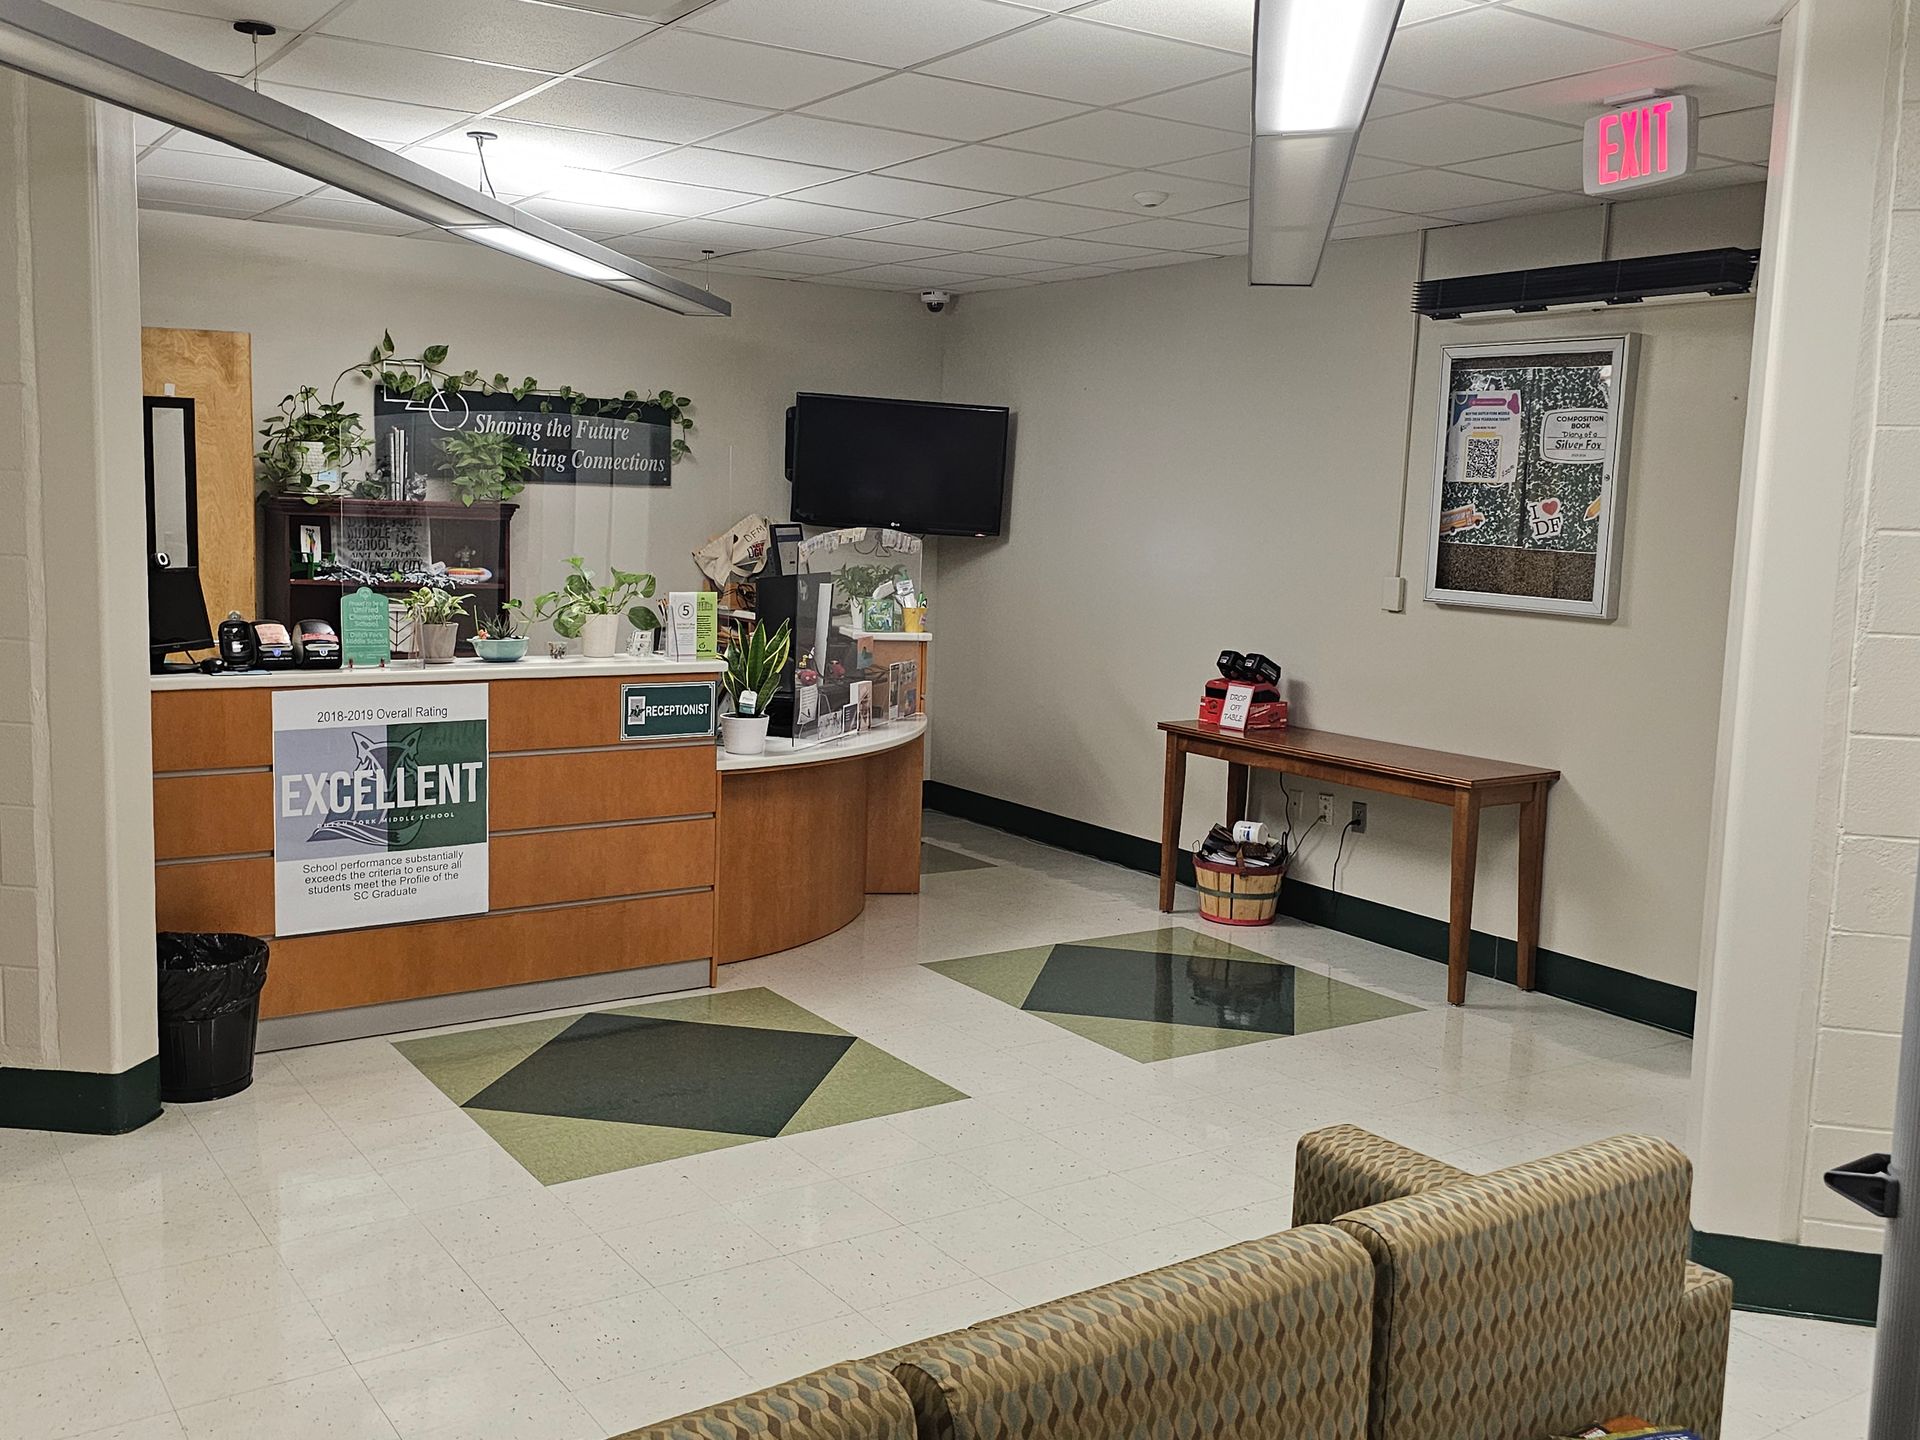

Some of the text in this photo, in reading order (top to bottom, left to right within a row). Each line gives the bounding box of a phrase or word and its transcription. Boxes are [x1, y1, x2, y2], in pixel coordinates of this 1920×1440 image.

[1599, 102, 1673, 185] EXIT
[474, 413, 630, 441] Shaping the Future
[1562, 431, 1582, 439] Diary
[1555, 439, 1602, 450] Silver Fox
[571, 449, 666, 473] Connections
[1531, 505, 1538, 520] I
[347, 527, 391, 539] MIDDLE
[743, 524, 765, 542] DFM
[1534, 517, 1561, 537] DF
[347, 539, 391, 551] SCHOOL
[402, 560, 423, 572] CITY
[682, 605, 690, 616] 5
[1229, 693, 1247, 701] DROP
[317, 706, 448, 723] 2018-2019 Overall Rating
[645, 703, 709, 717] RECEPTIONIST
[1223, 713, 1243, 722] TABLE
[281, 761, 483, 818] EXCELLENT
[382, 815, 415, 823] MIDDLE
[420, 812, 455, 821] SCHOOL
[303, 850, 464, 874] School performance substantially
[304, 860, 462, 884] exceeds the criteria to ensure all
[308, 871, 459, 895] students meet the Profile of the
[353, 887, 417, 901] SC Graduate
